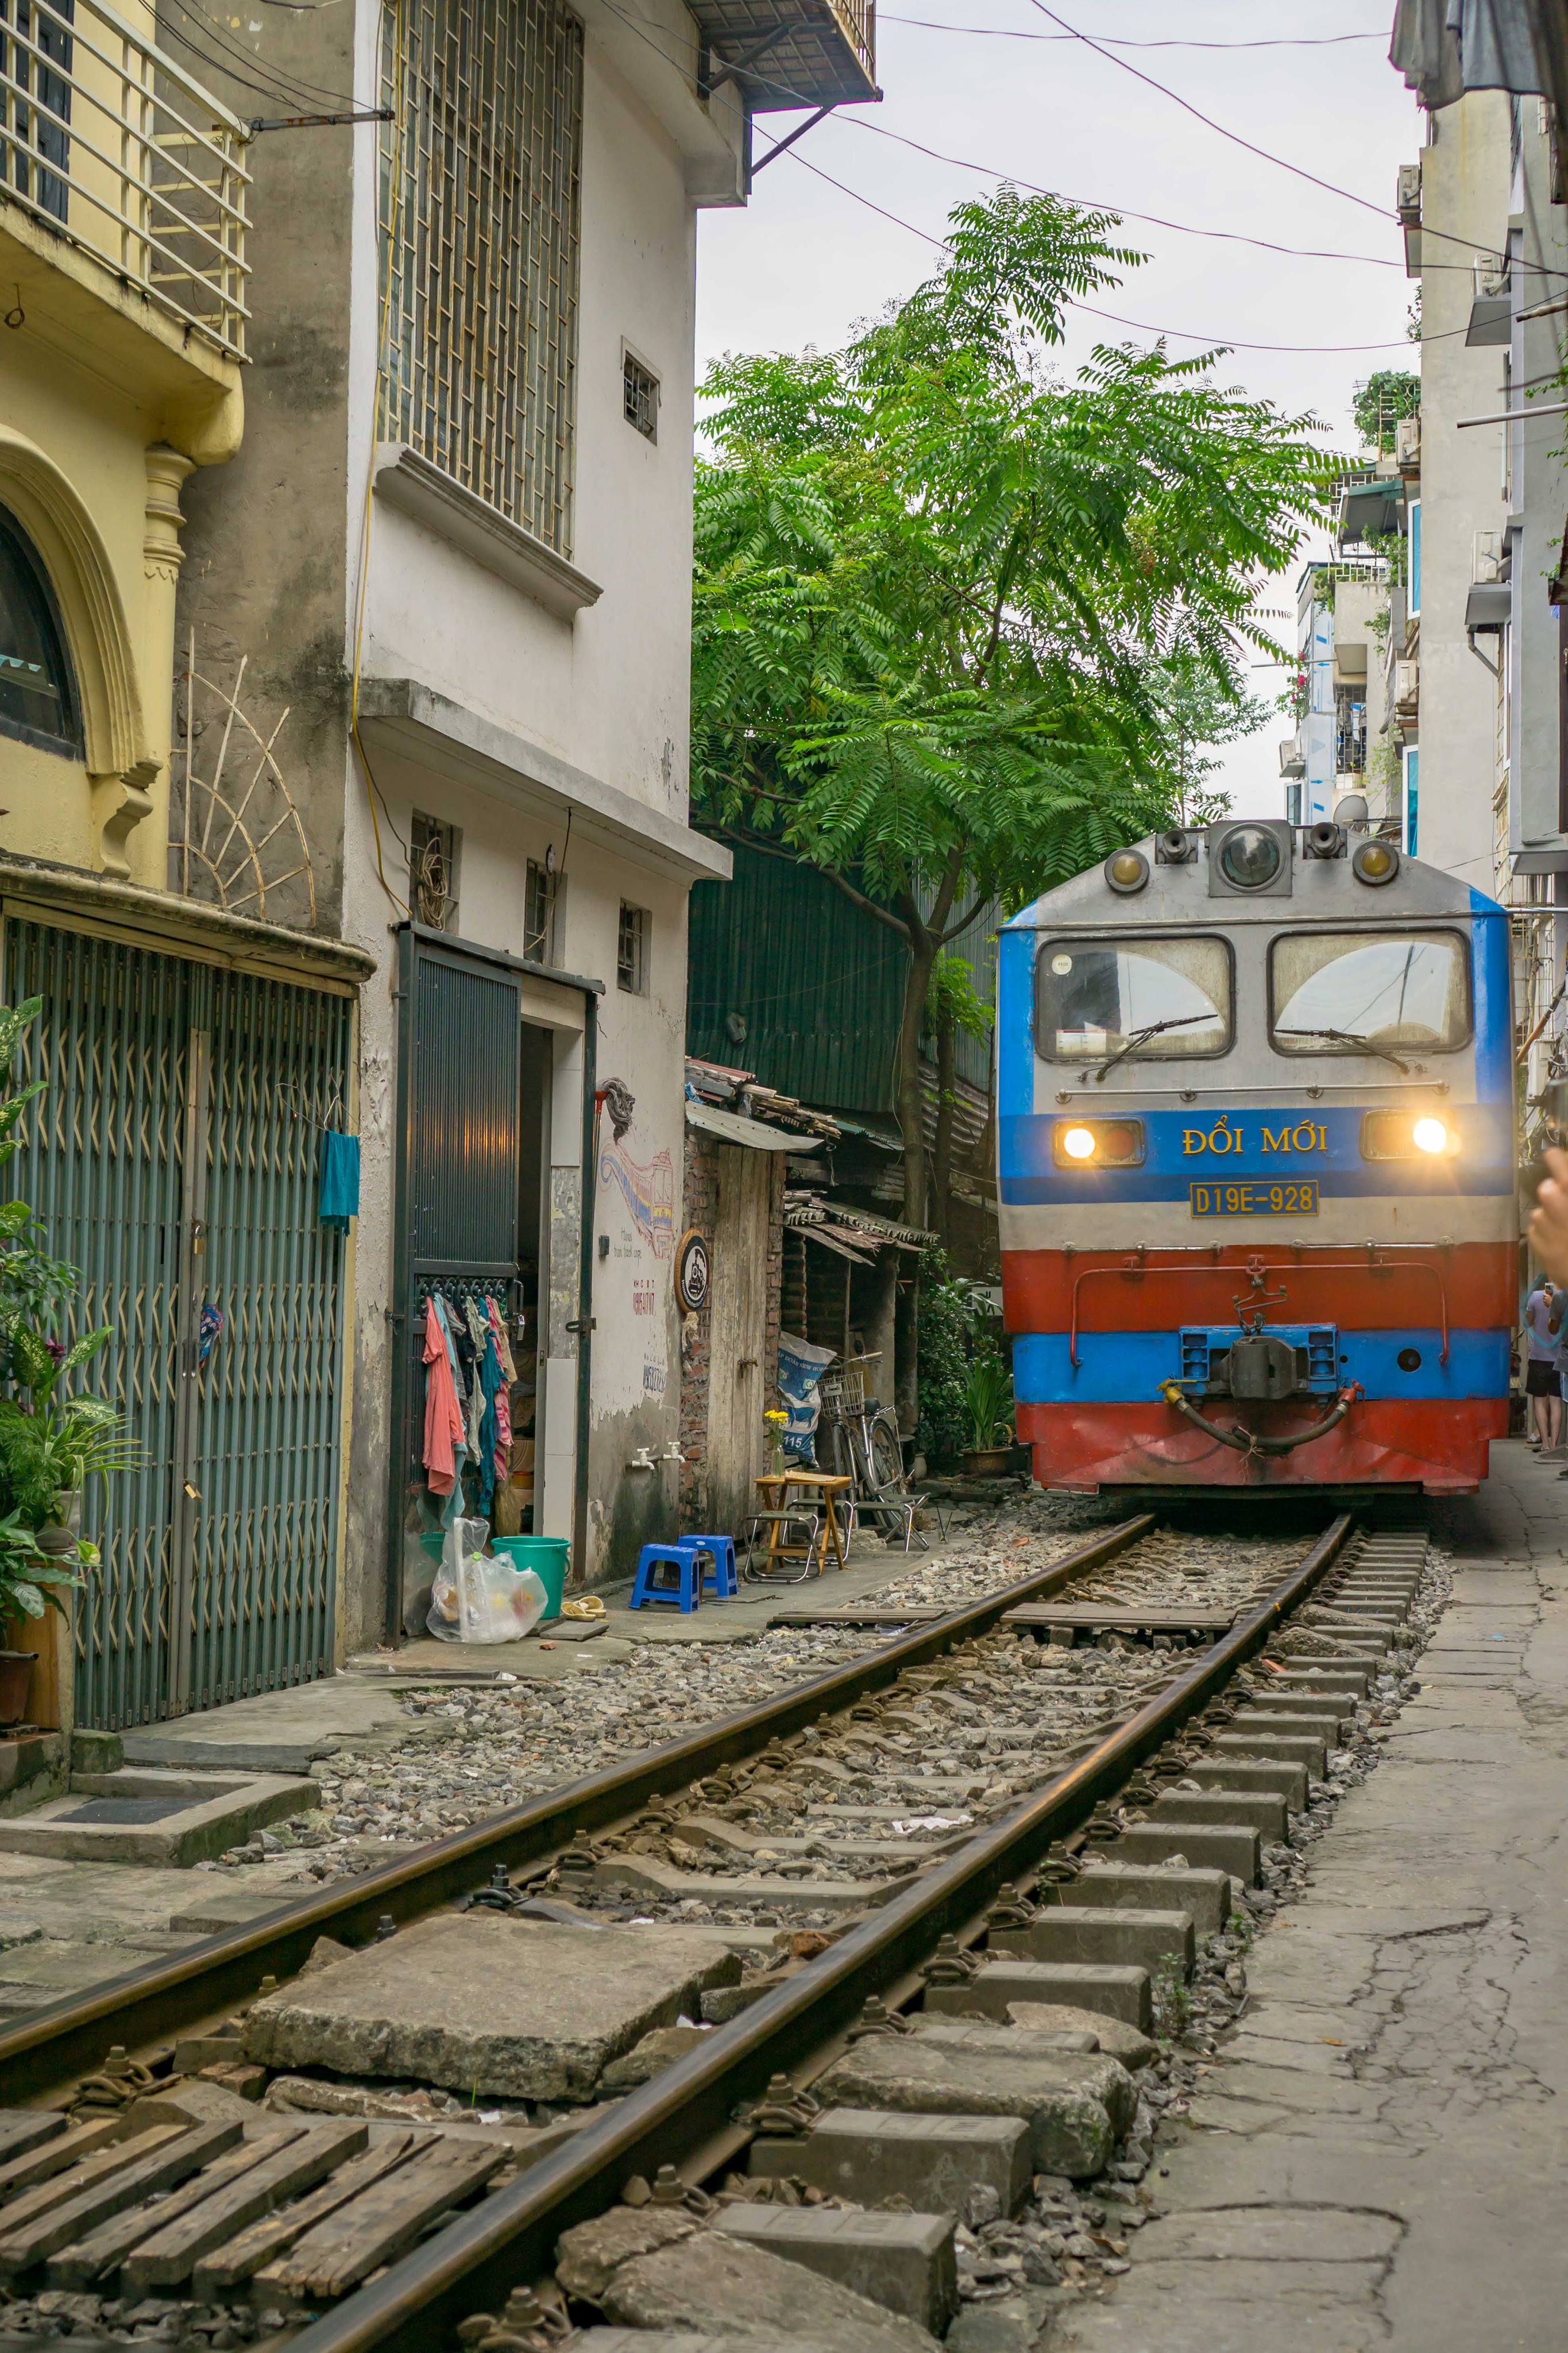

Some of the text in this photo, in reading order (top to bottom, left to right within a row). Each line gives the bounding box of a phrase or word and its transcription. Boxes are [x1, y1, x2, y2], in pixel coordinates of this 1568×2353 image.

[1182, 1115, 1328, 1155] ĐỔI MỚI
[1196, 1185, 1313, 1213] D19E-928
[783, 1435, 802, 1448] 115
